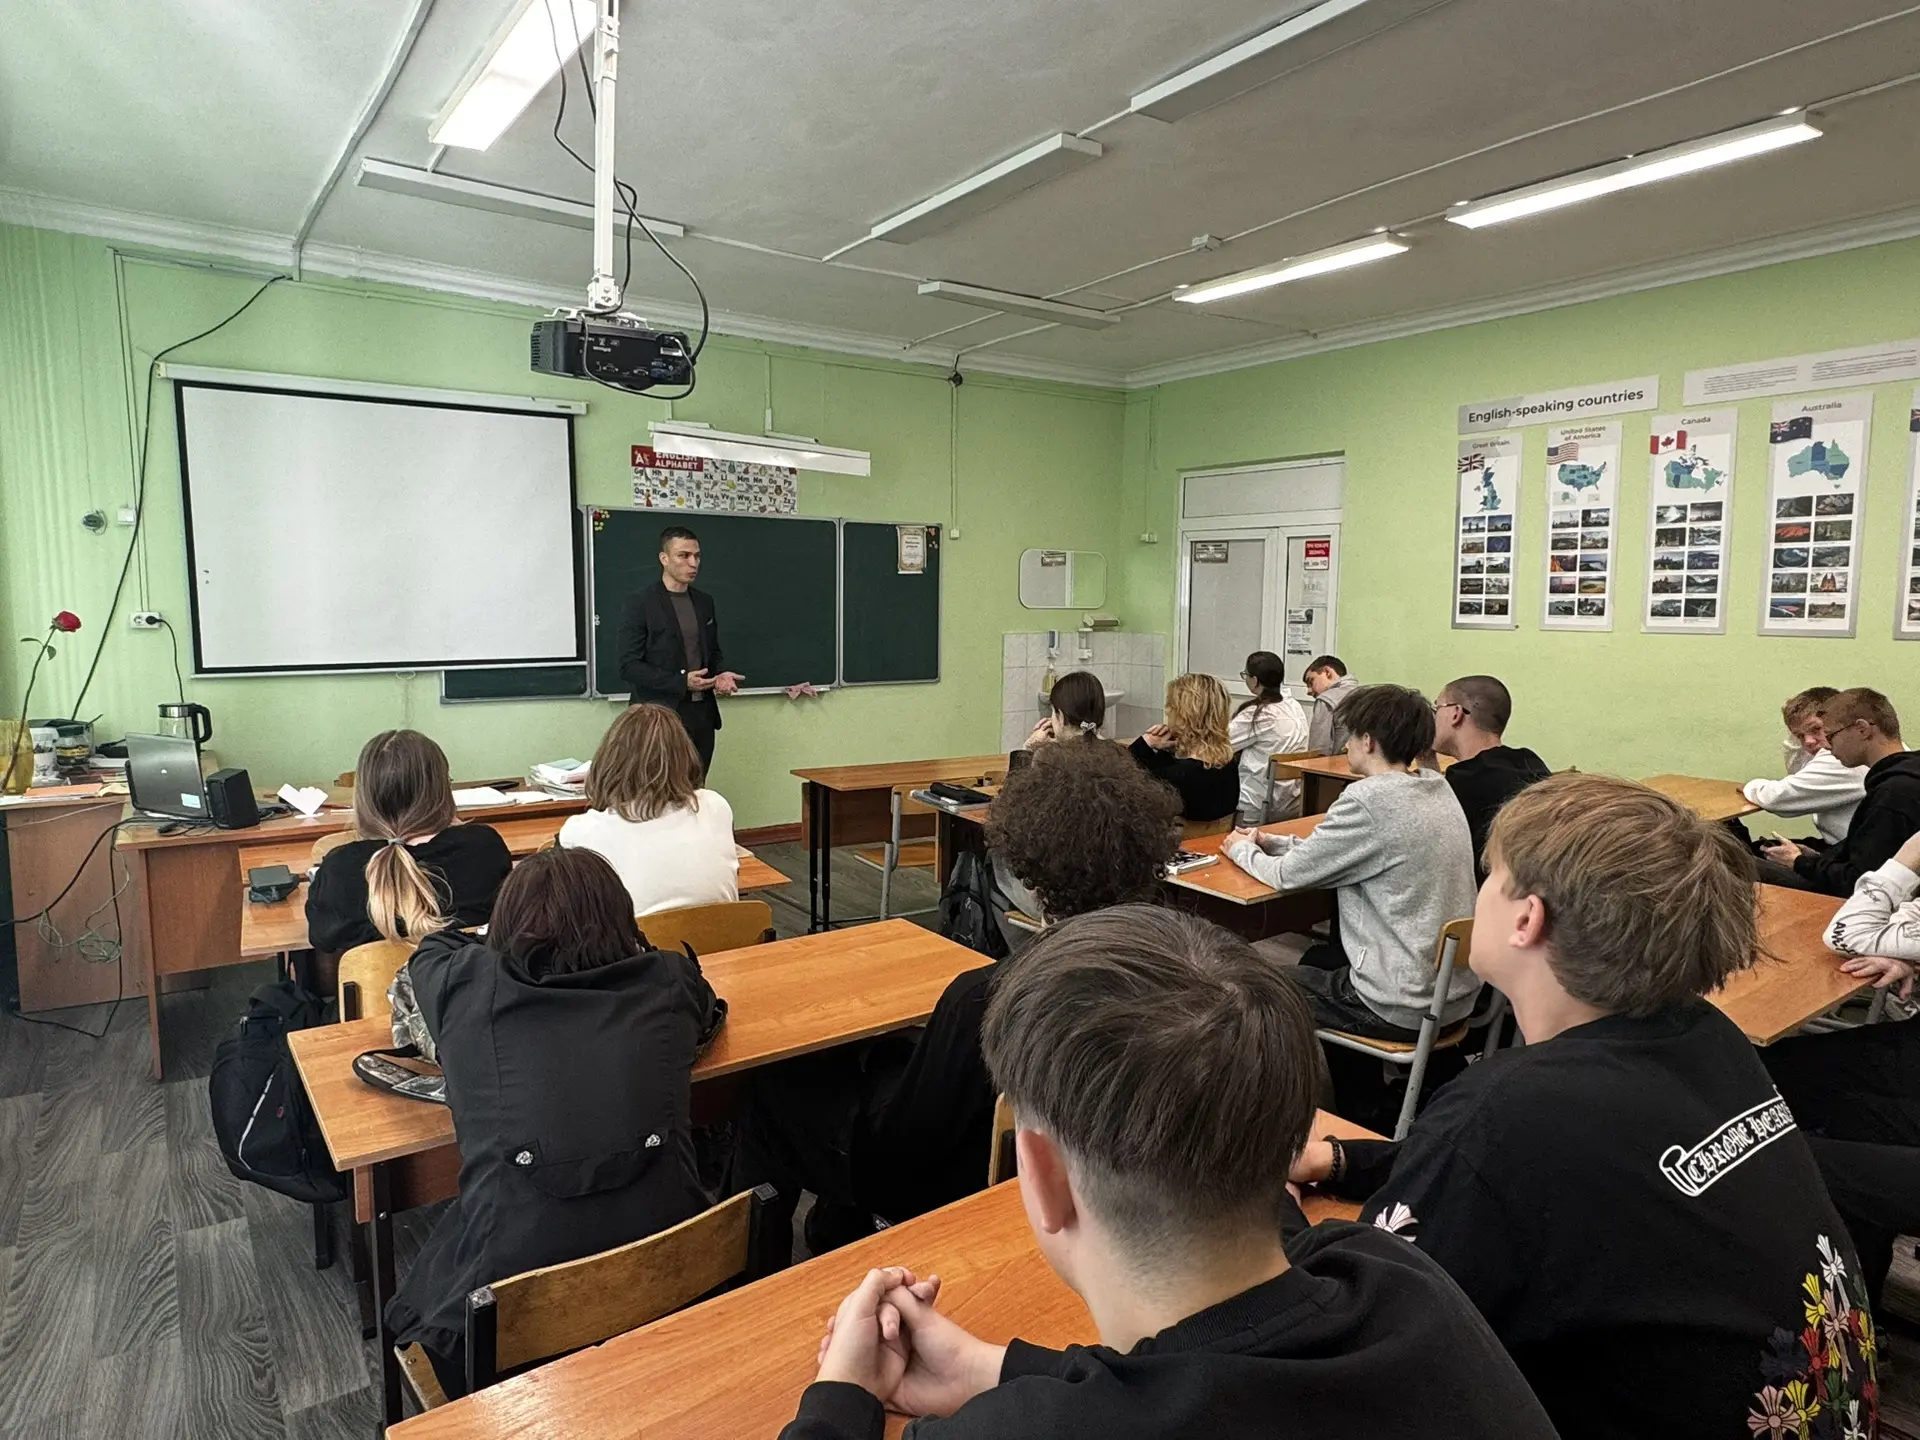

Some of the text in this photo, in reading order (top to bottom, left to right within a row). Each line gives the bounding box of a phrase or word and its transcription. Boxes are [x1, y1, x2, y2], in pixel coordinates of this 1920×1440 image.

[1468, 389, 1644, 423] English-speaking countries
[1801, 401, 1842, 412] Australia
[1681, 416, 1711, 425] Canada
[1560, 425, 1606, 436] United States
[1572, 432, 1601, 441] America
[654, 459, 698, 470] ALPHABET
[704, 472, 714, 480] Kk
[1687, 1122, 1755, 1183] CHROME
